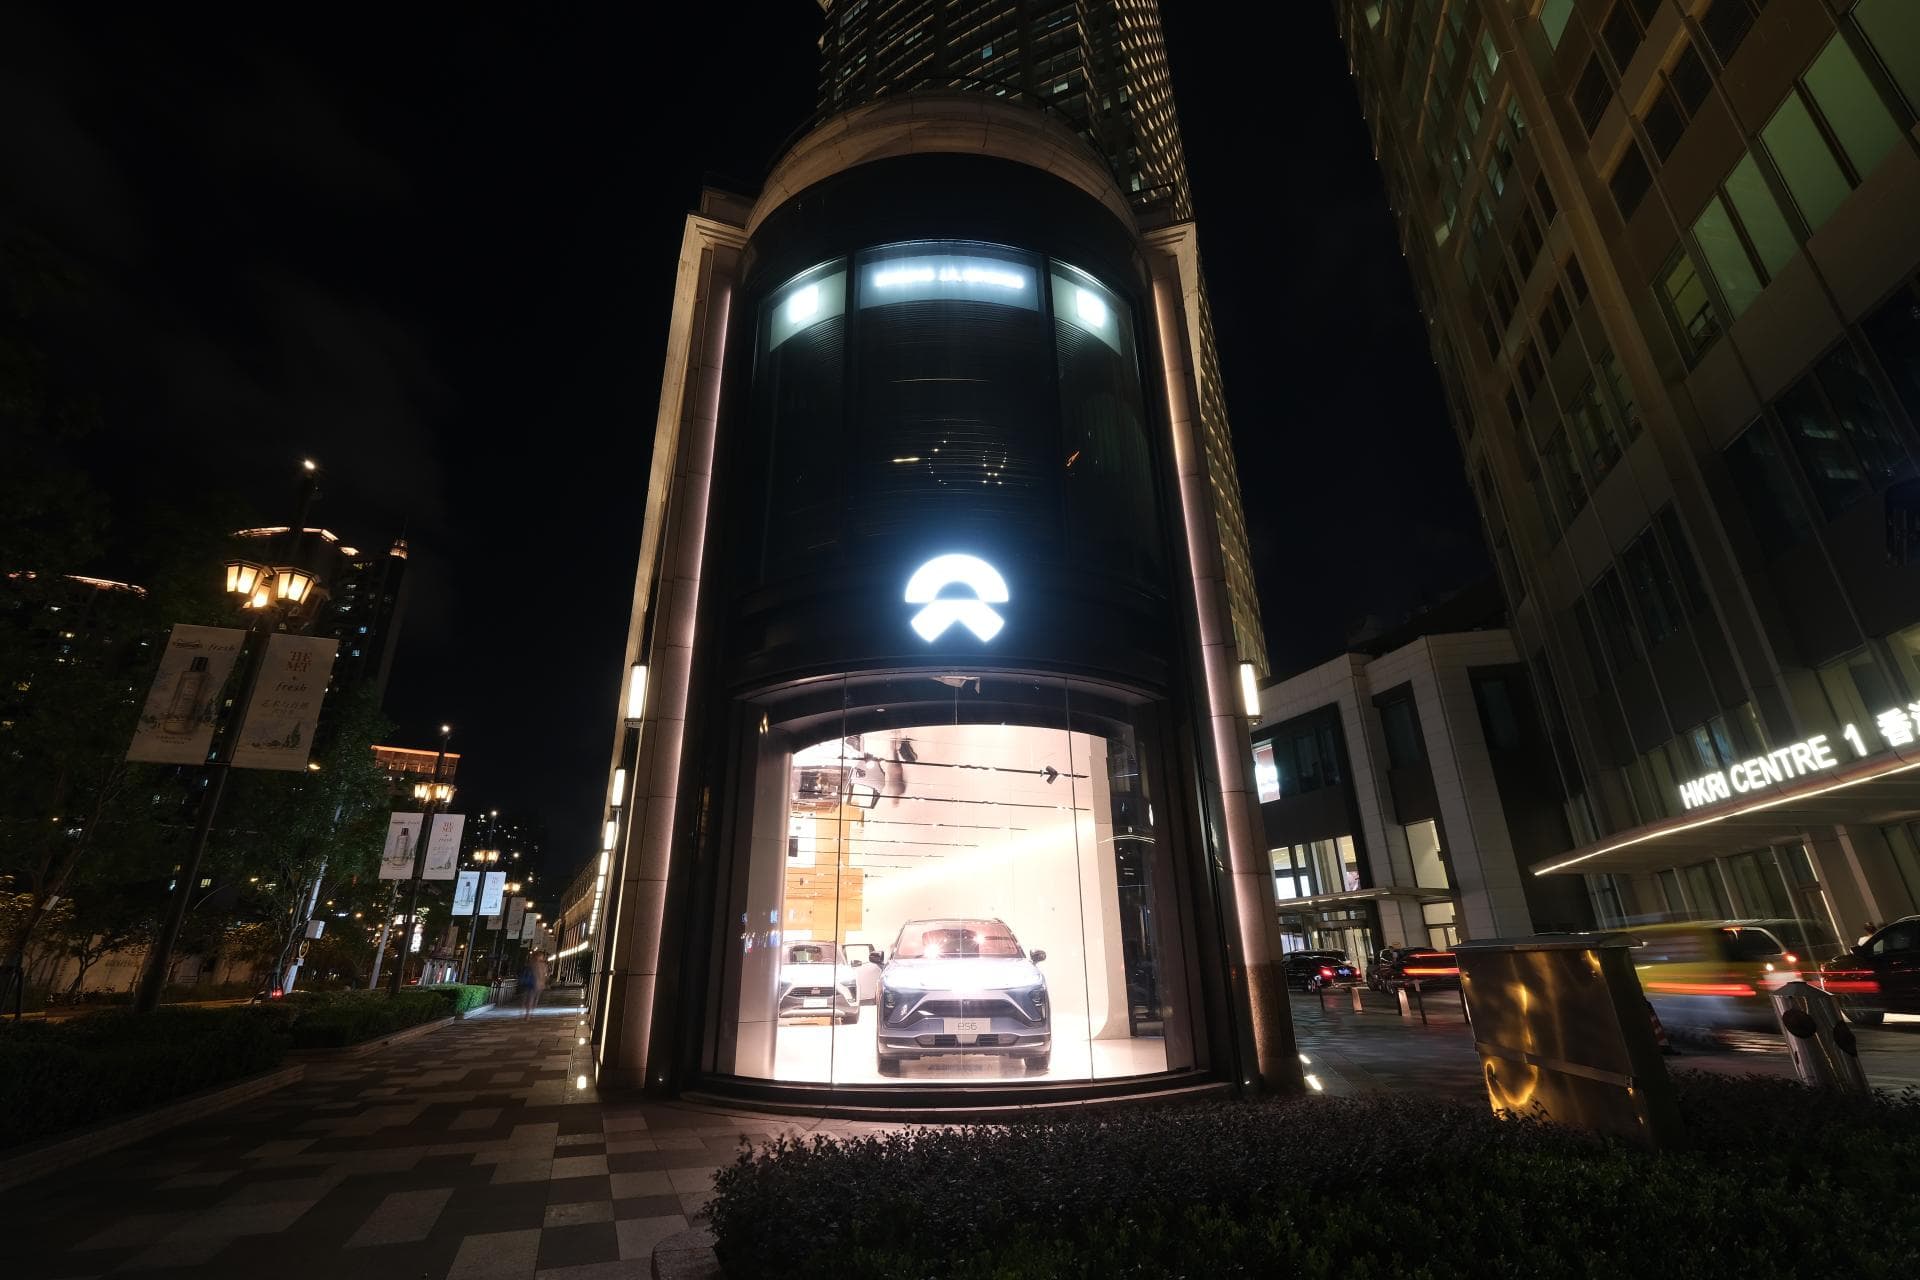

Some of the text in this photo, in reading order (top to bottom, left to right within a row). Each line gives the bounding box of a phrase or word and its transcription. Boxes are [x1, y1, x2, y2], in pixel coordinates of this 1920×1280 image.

[275, 681, 309, 692] fresh
[1679, 723, 1867, 809] HKRI CENTRE 1
